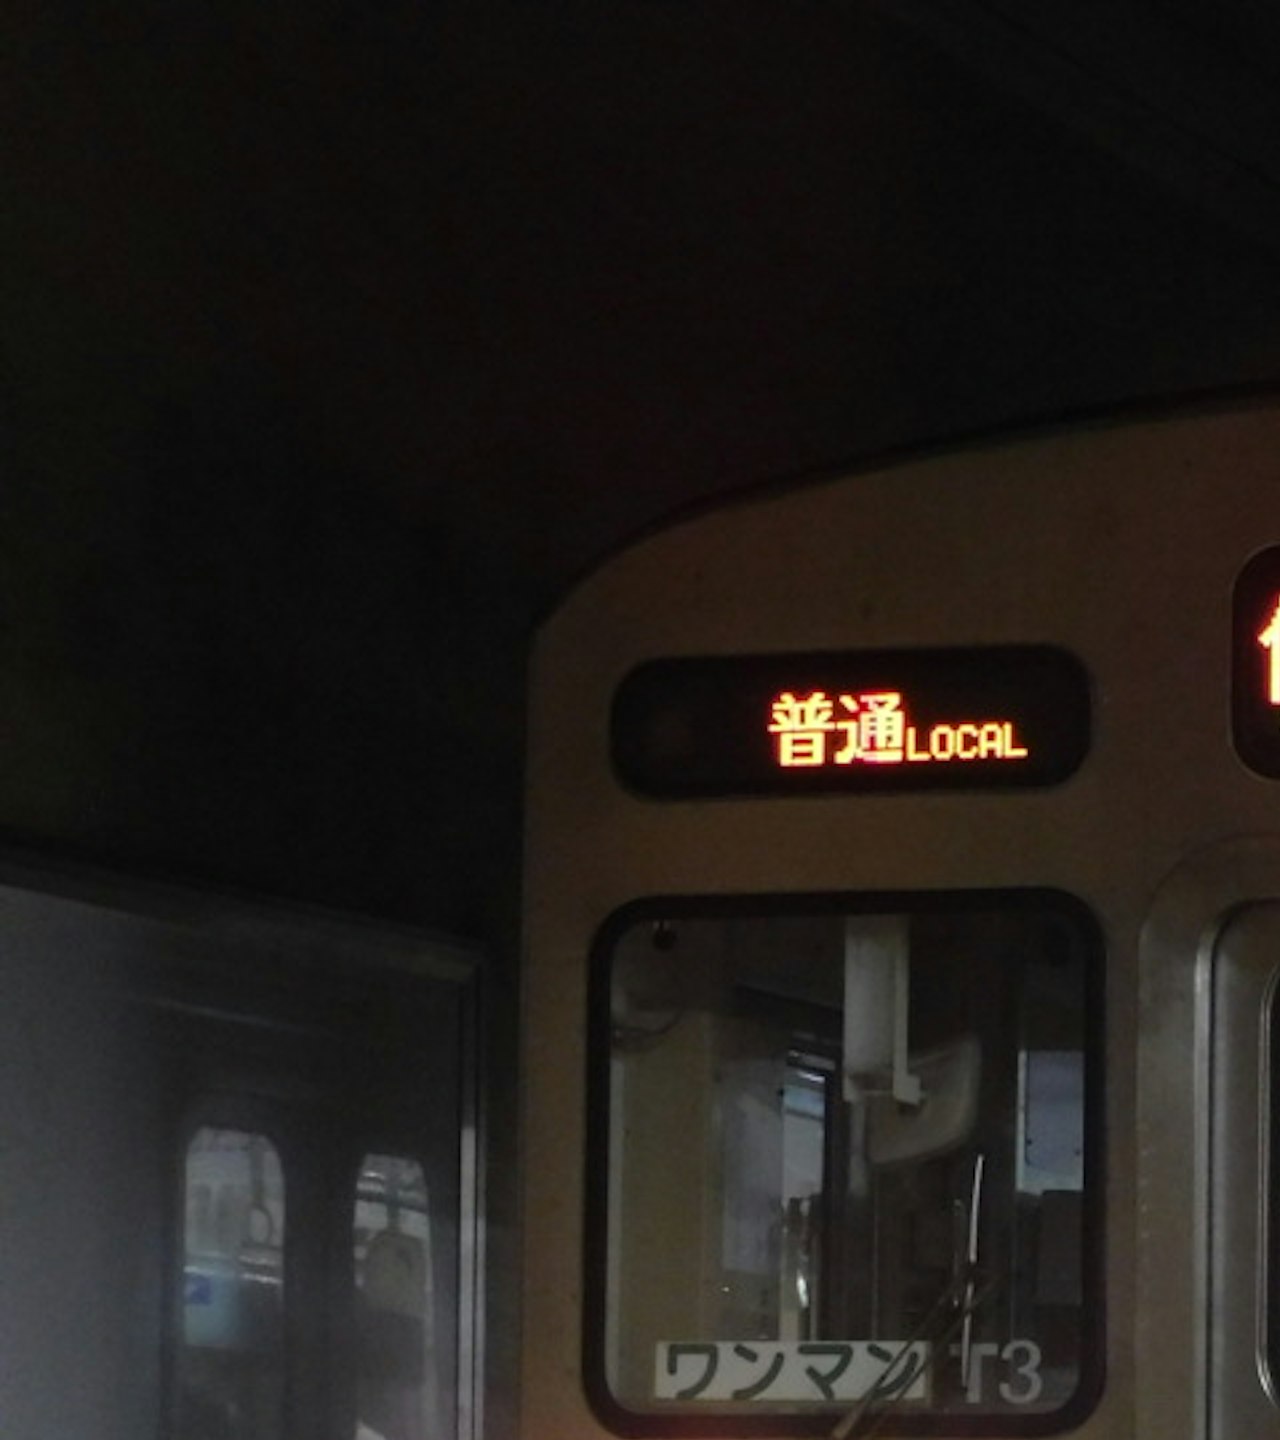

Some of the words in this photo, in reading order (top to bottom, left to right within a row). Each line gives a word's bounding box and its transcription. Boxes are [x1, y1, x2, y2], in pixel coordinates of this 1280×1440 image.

[767, 691, 905, 767] 普通
[906, 721, 1029, 762] LOCAL
[667, 1343, 921, 1400] ワンマン
[950, 1339, 1044, 1404] T3
